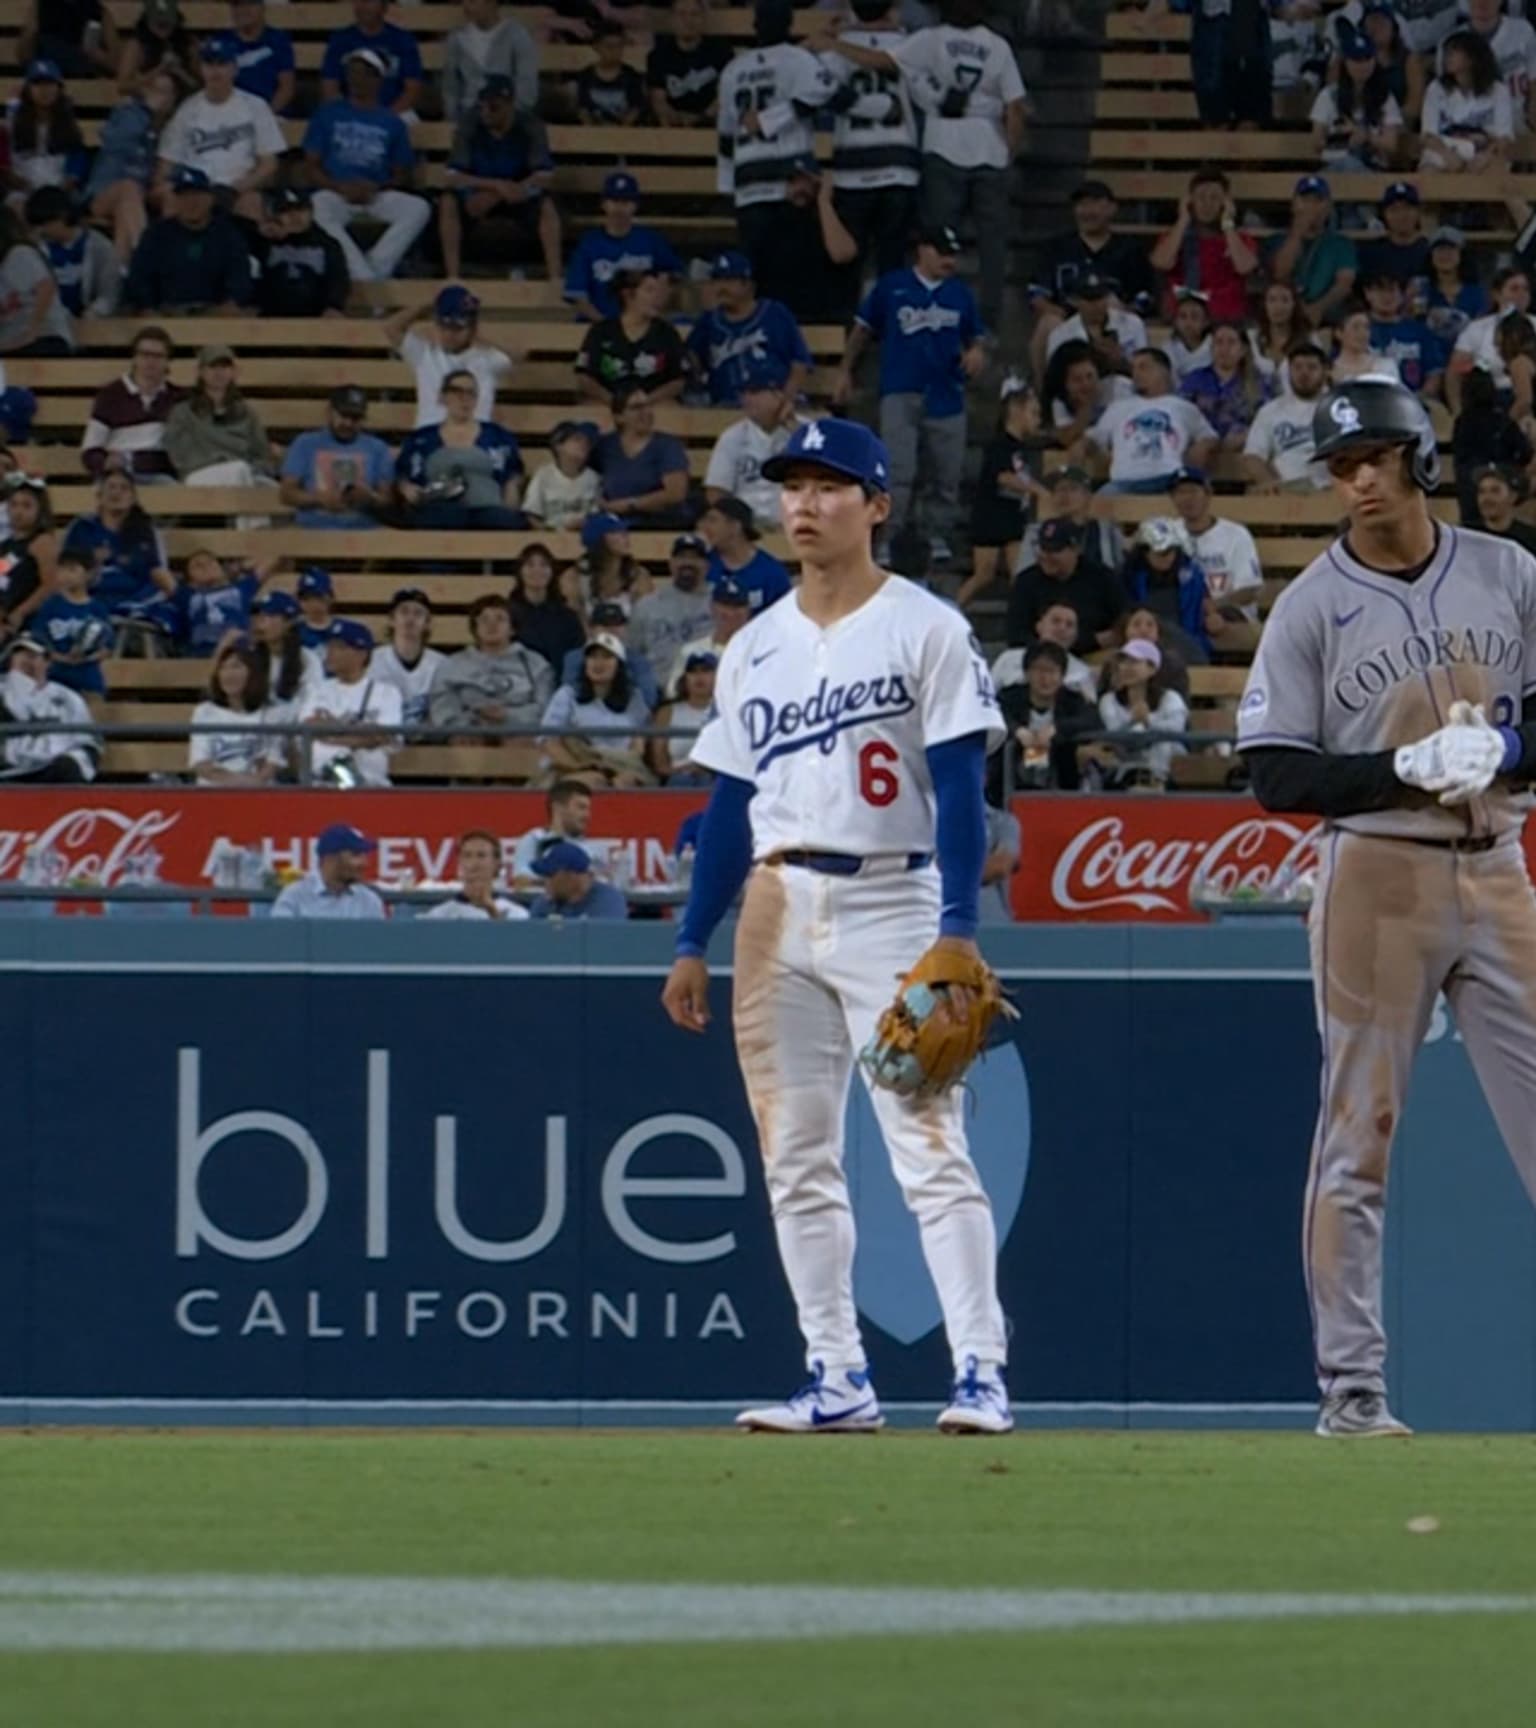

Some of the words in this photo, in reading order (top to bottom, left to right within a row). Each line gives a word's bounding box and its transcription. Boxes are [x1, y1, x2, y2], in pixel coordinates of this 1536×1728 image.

[1333, 626, 1523, 714] COLORADO
[740, 676, 914, 758] Dodgers
[859, 741, 899, 807] 6
[176, 1046, 748, 1265] blue
[175, 1288, 748, 1340] CALIFORNIA
